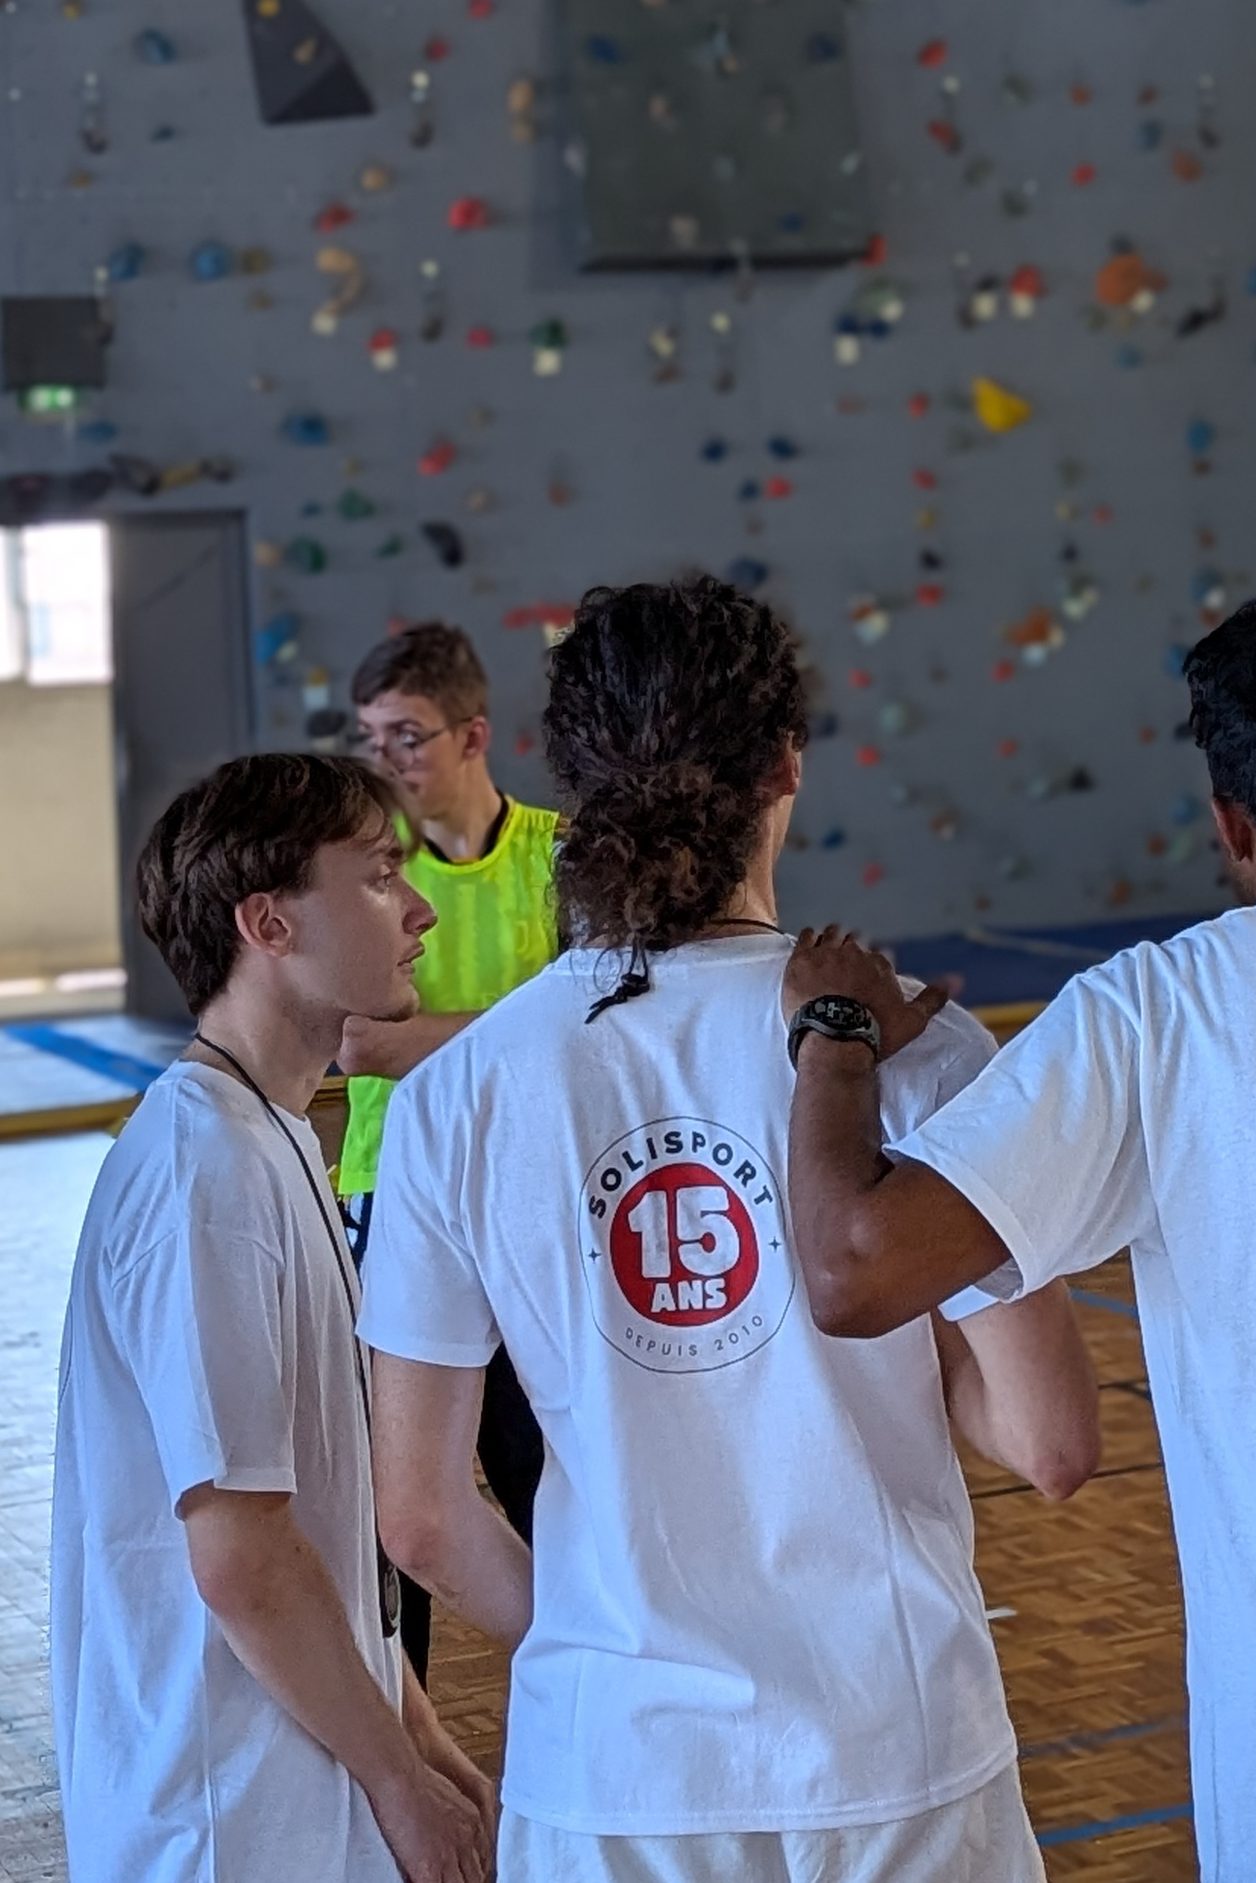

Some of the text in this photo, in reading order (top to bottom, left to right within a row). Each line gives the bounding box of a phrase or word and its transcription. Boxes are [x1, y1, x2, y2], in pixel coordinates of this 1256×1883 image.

[588, 1131, 773, 1219] SOLISPORT
[627, 1186, 740, 1278] 15
[651, 1279, 727, 1312] ANS
[625, 1315, 763, 1356] DEPUIS 2010
